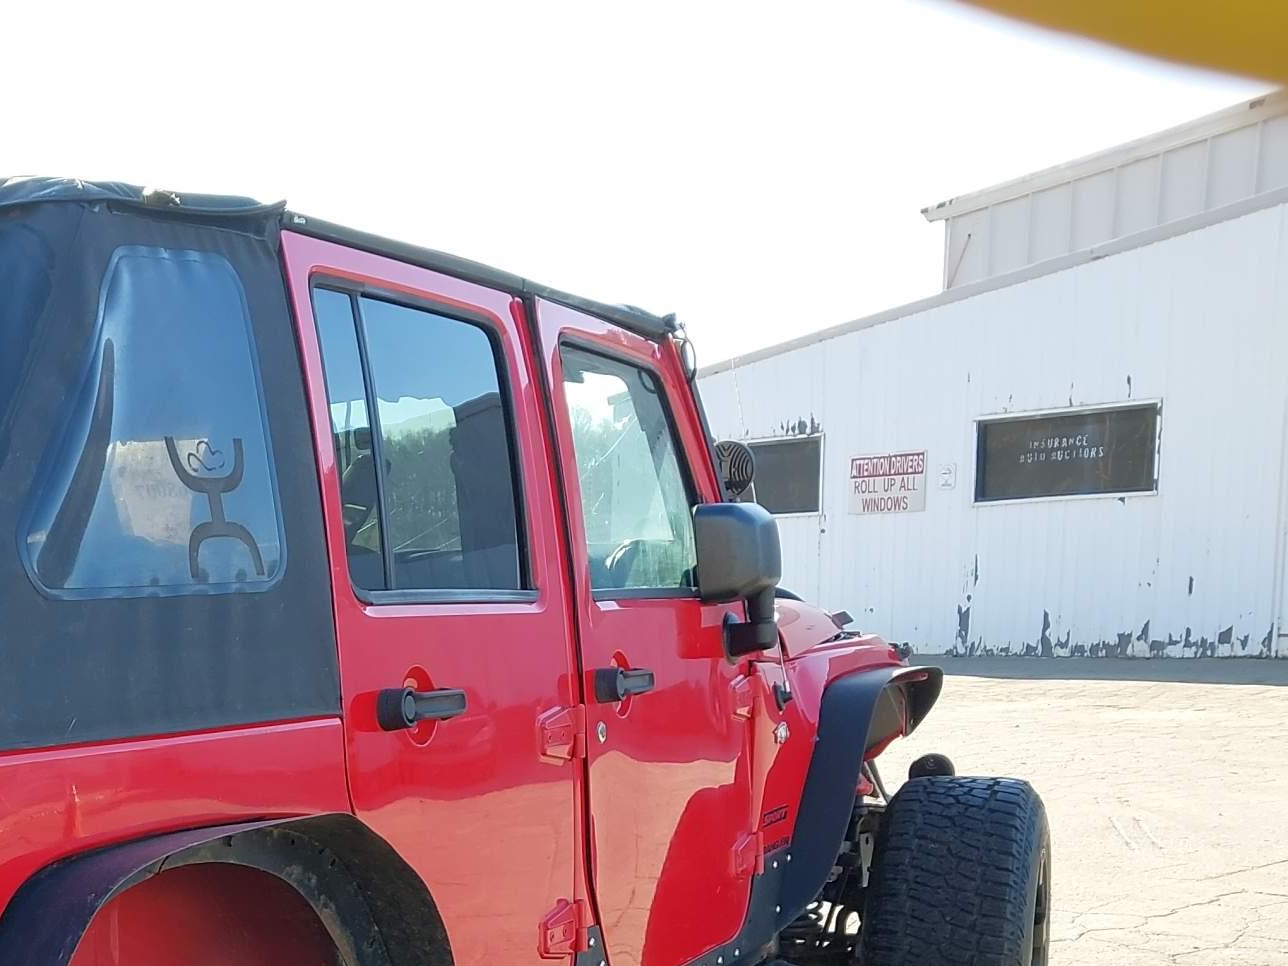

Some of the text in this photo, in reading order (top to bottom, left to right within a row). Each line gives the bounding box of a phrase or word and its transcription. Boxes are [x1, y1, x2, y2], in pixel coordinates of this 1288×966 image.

[851, 454, 924, 477] ATTENTION DRIVERS
[854, 475, 919, 495] ROLL UP ALL
[862, 495, 909, 512] WINDOWS
